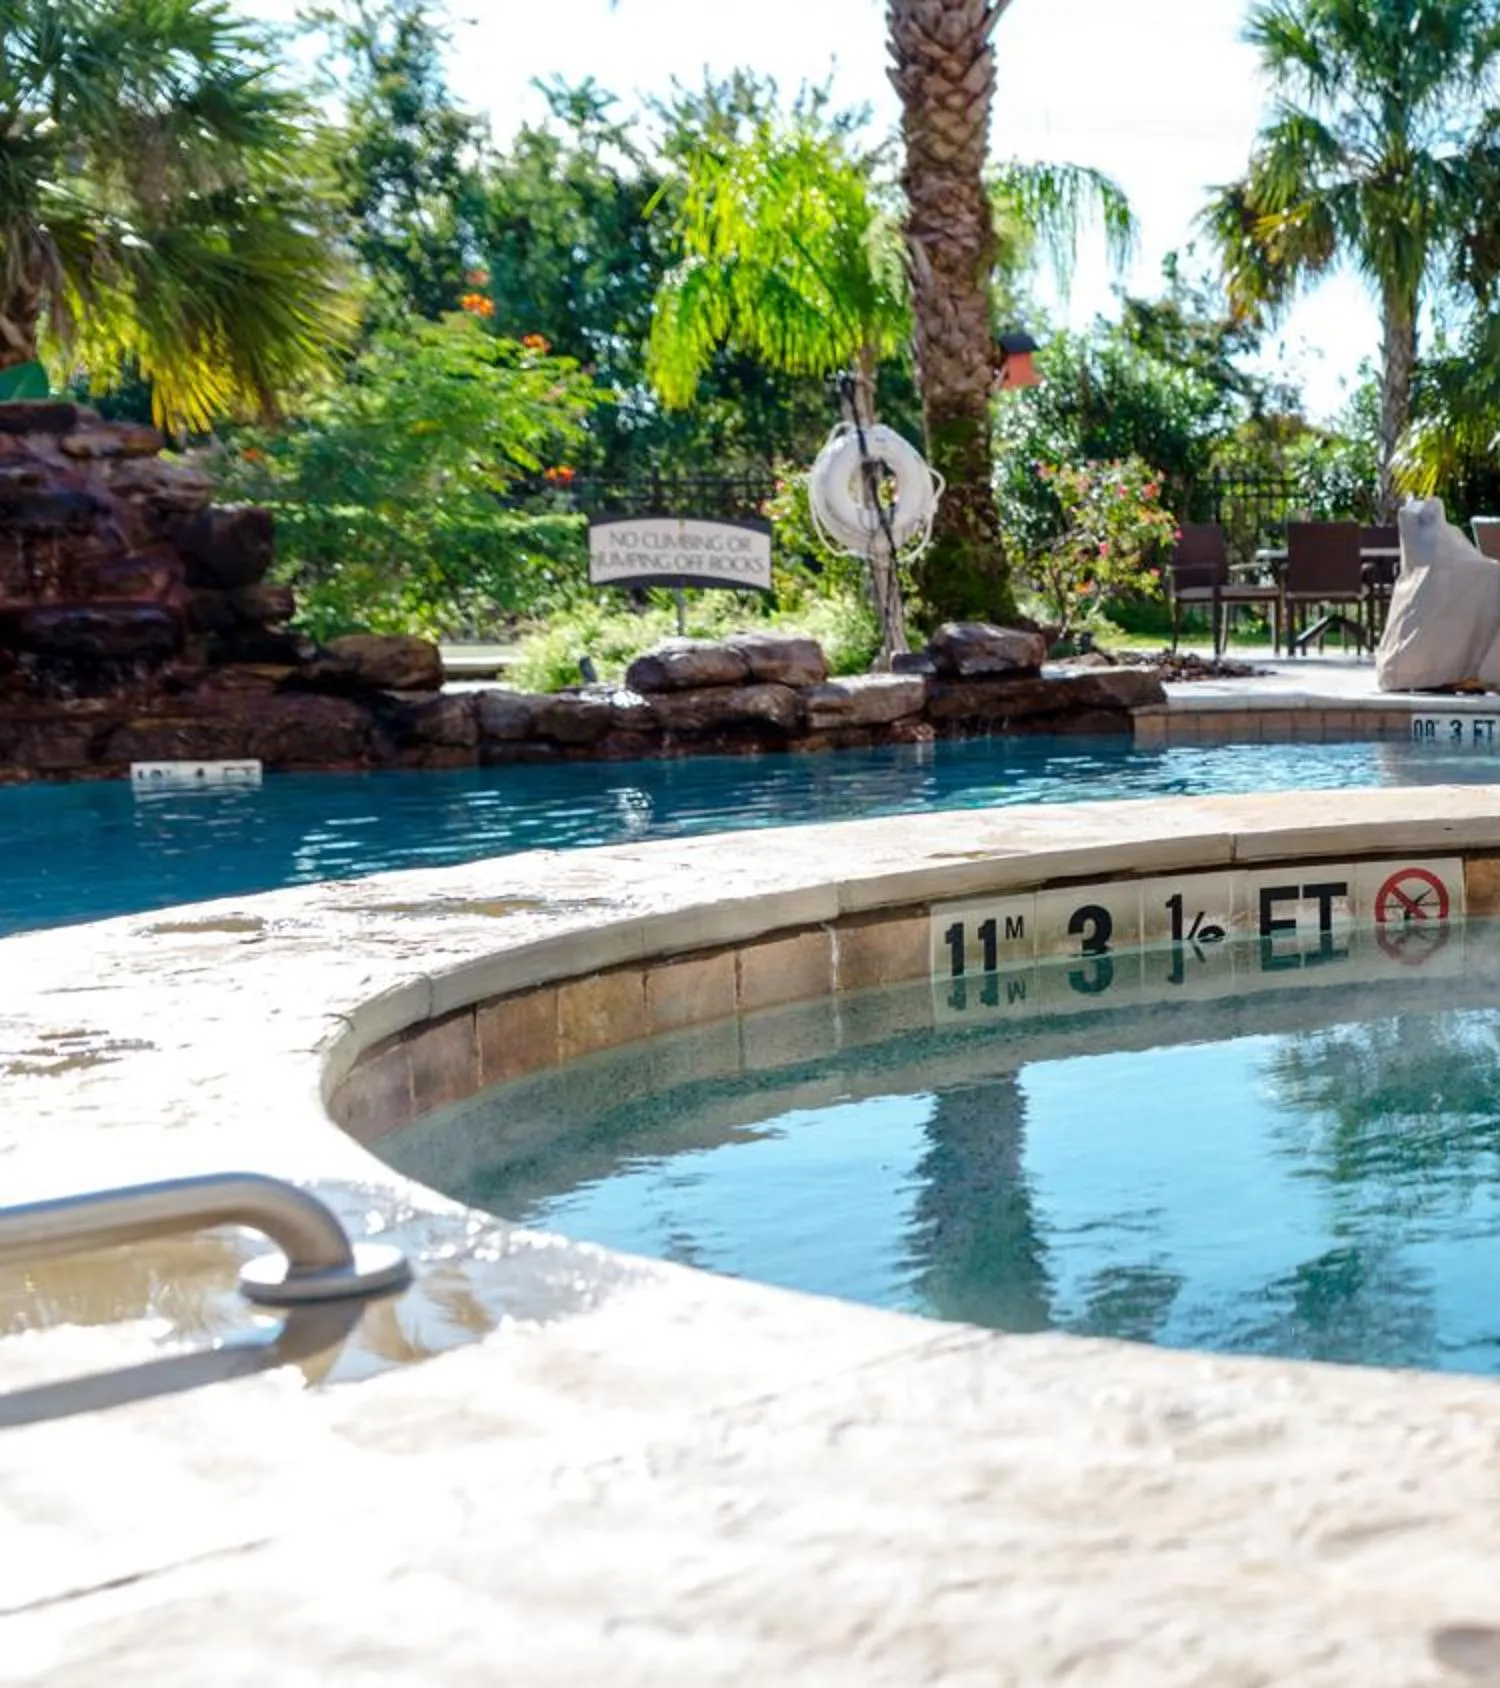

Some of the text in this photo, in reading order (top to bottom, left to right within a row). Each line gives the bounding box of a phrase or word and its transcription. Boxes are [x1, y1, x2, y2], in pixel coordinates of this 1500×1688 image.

[610, 530, 752, 553] NO CLIMBING OR
[597, 551, 765, 574] JUMPING OFF ROCKS
[1067, 904, 1113, 957] 3
[1259, 881, 1348, 937] FT
